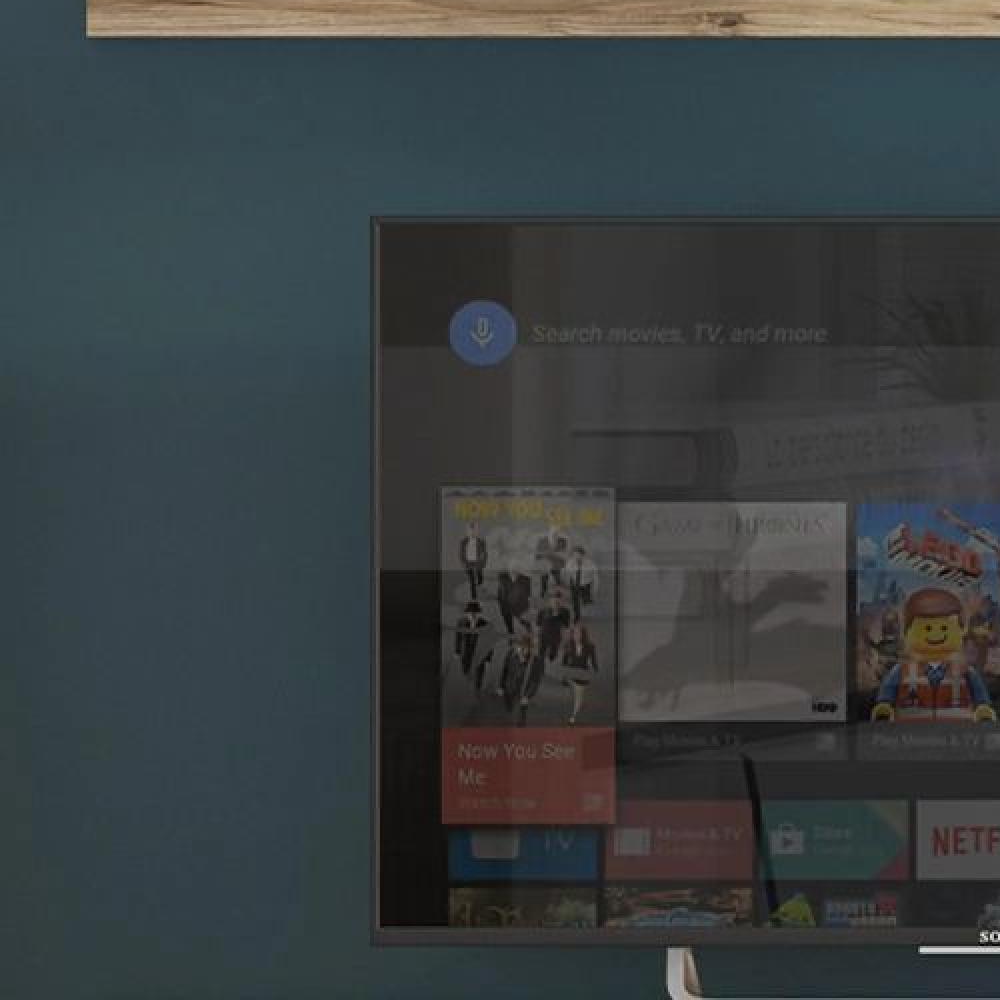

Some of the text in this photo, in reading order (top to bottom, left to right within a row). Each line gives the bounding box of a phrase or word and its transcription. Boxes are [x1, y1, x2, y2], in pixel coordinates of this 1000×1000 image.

[533, 325, 600, 344] Search
[606, 327, 685, 346] movies,
[693, 325, 724, 346] TV,
[730, 325, 769, 344] and
[457, 743, 576, 760] Now You See
[458, 769, 487, 786] Me
